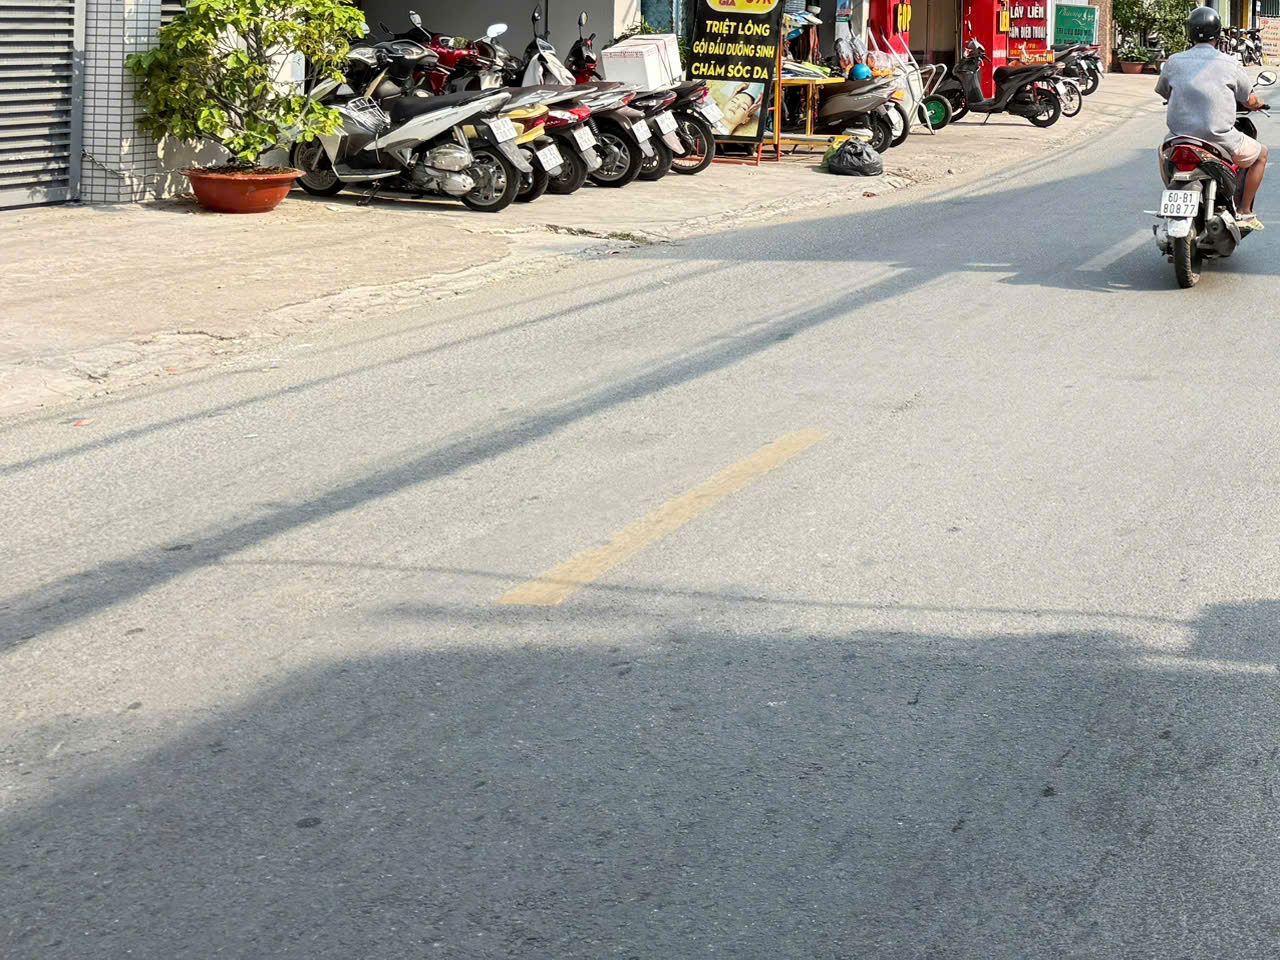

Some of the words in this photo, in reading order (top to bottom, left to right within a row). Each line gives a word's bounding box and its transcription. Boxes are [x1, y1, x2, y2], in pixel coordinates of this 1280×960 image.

[706, 19, 736, 36] TRIỆT
[738, 20, 770, 36] LÔNG
[693, 38, 707, 56] GỘI
[756, 44, 775, 58] SINH
[691, 61, 724, 76] CHĂM
[727, 62, 751, 78] SÓC
[753, 66, 769, 79] DA
